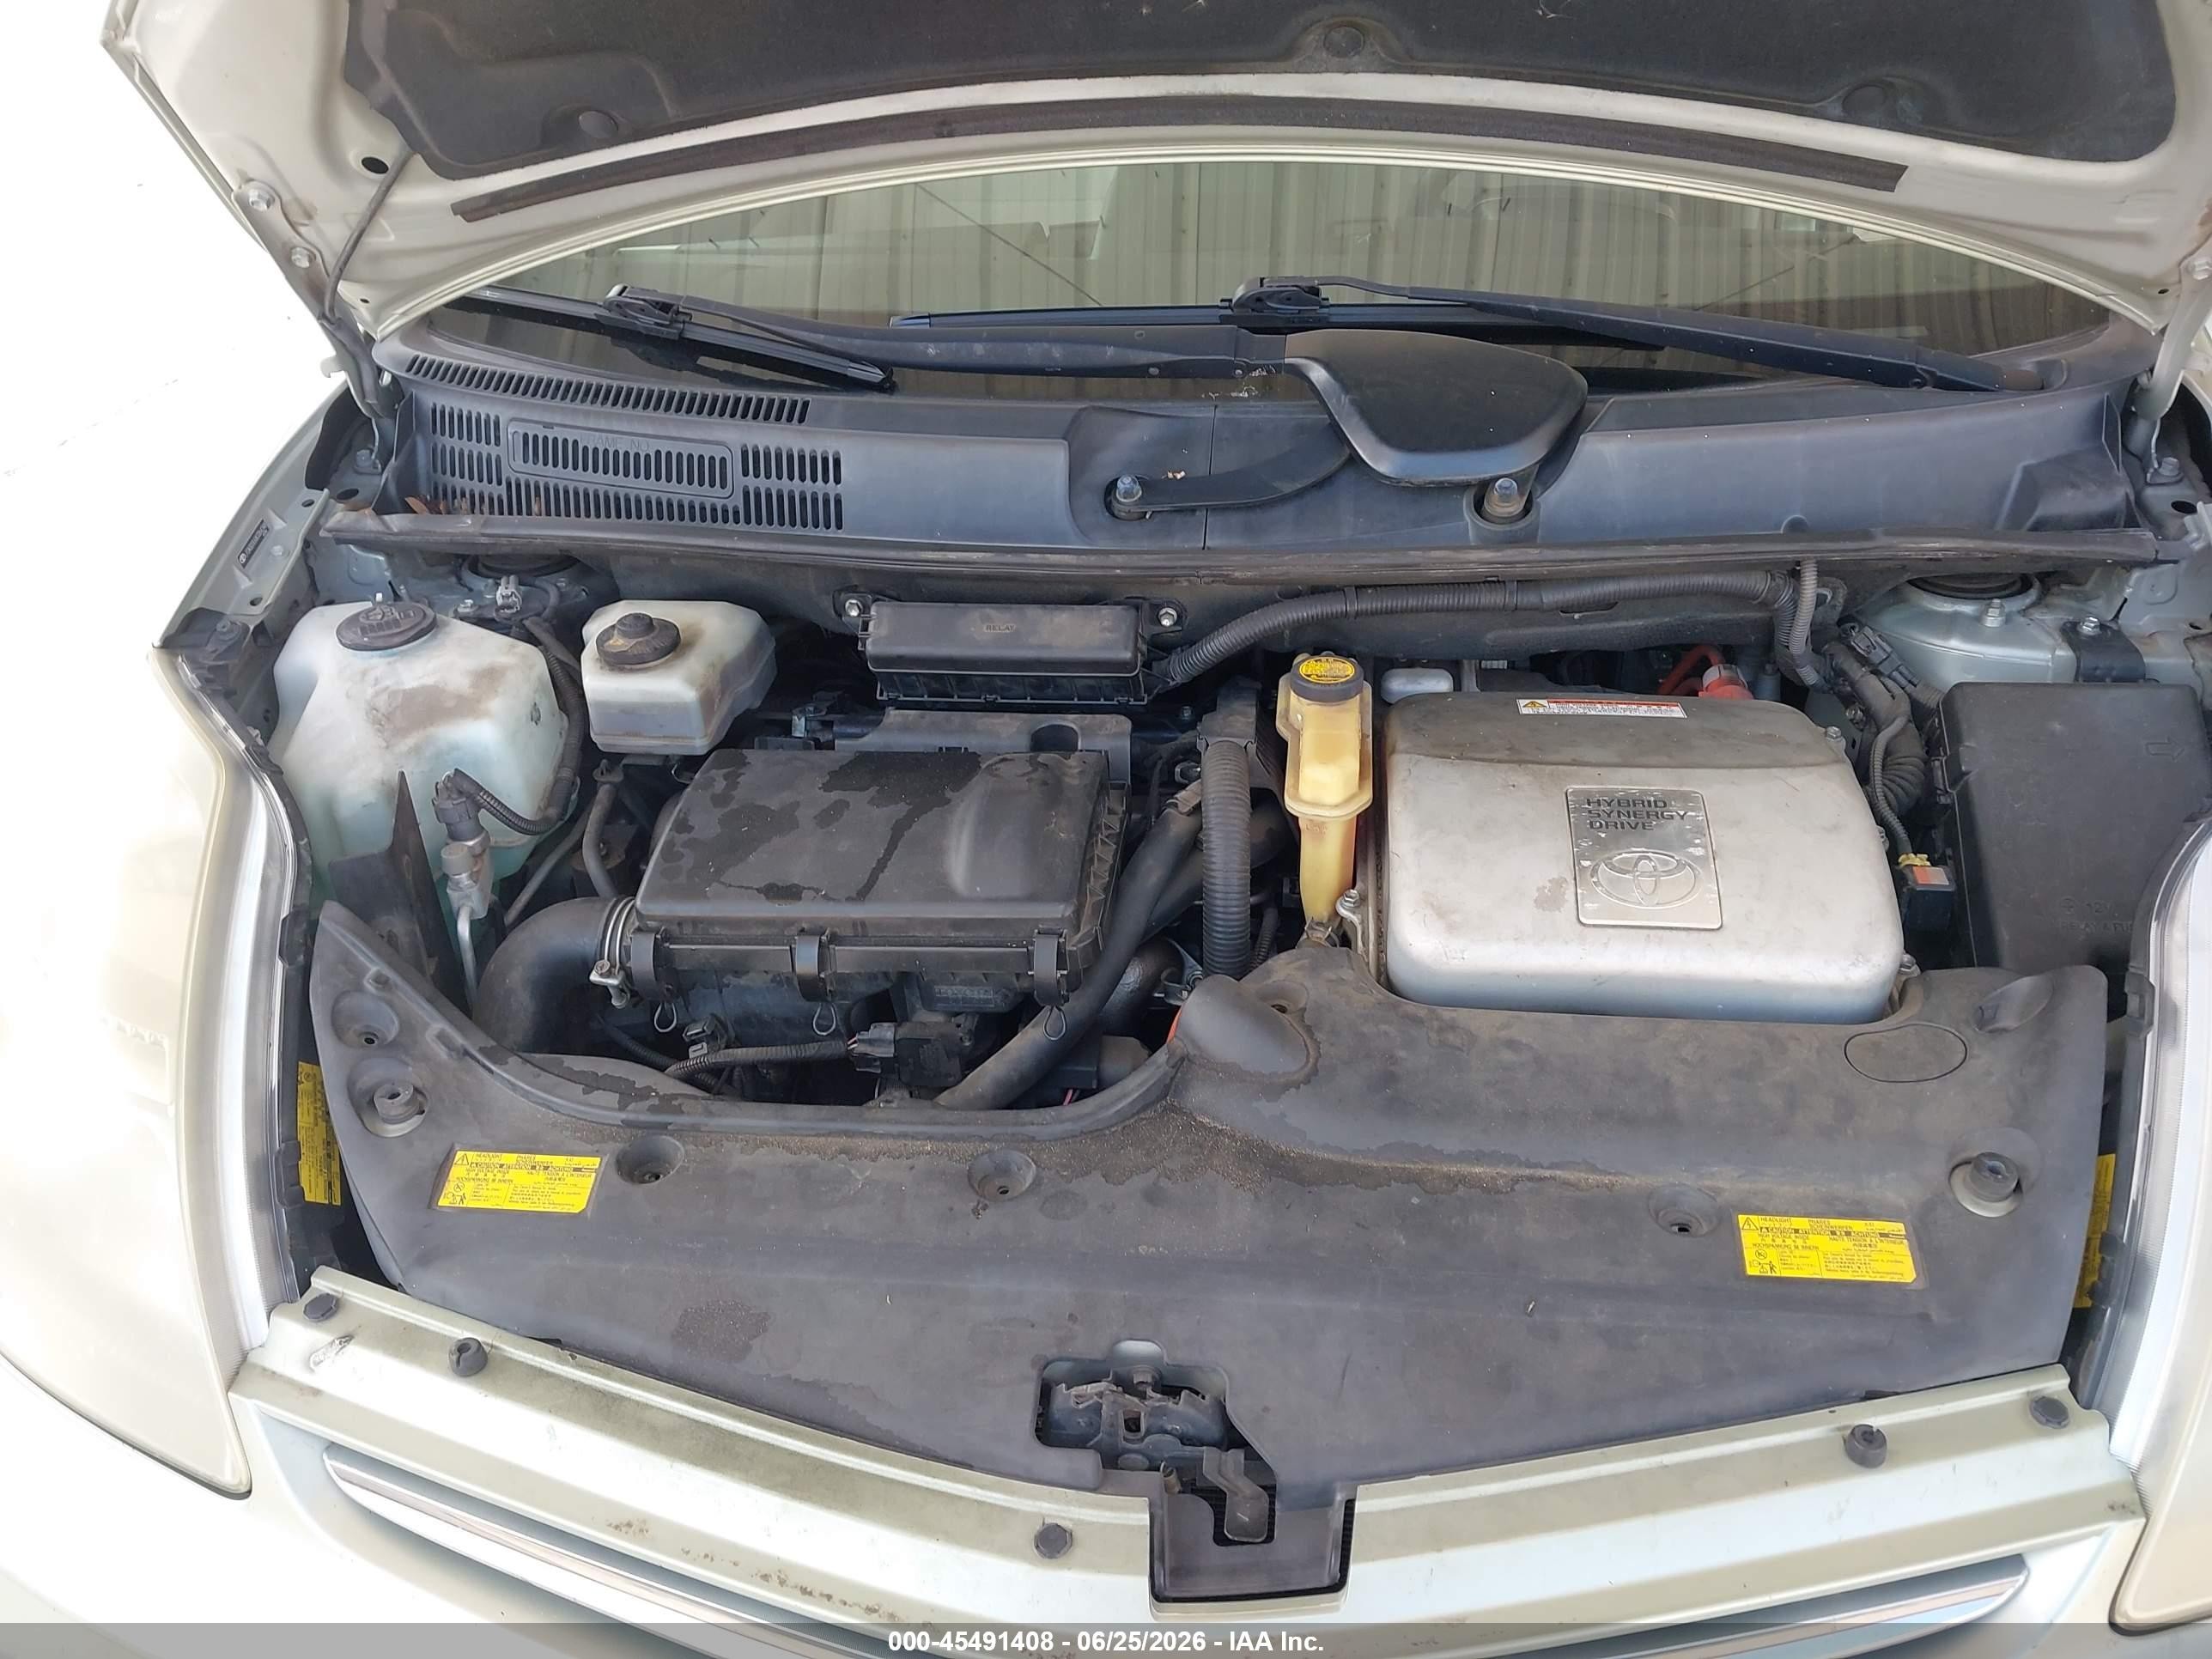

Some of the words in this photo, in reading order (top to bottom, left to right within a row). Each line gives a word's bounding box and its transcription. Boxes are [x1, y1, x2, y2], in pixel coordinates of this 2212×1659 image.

[1587, 798, 1668, 809] HYBRID
[1588, 809, 1689, 820] SYNERGY
[1589, 820, 1656, 830] DRIVE
